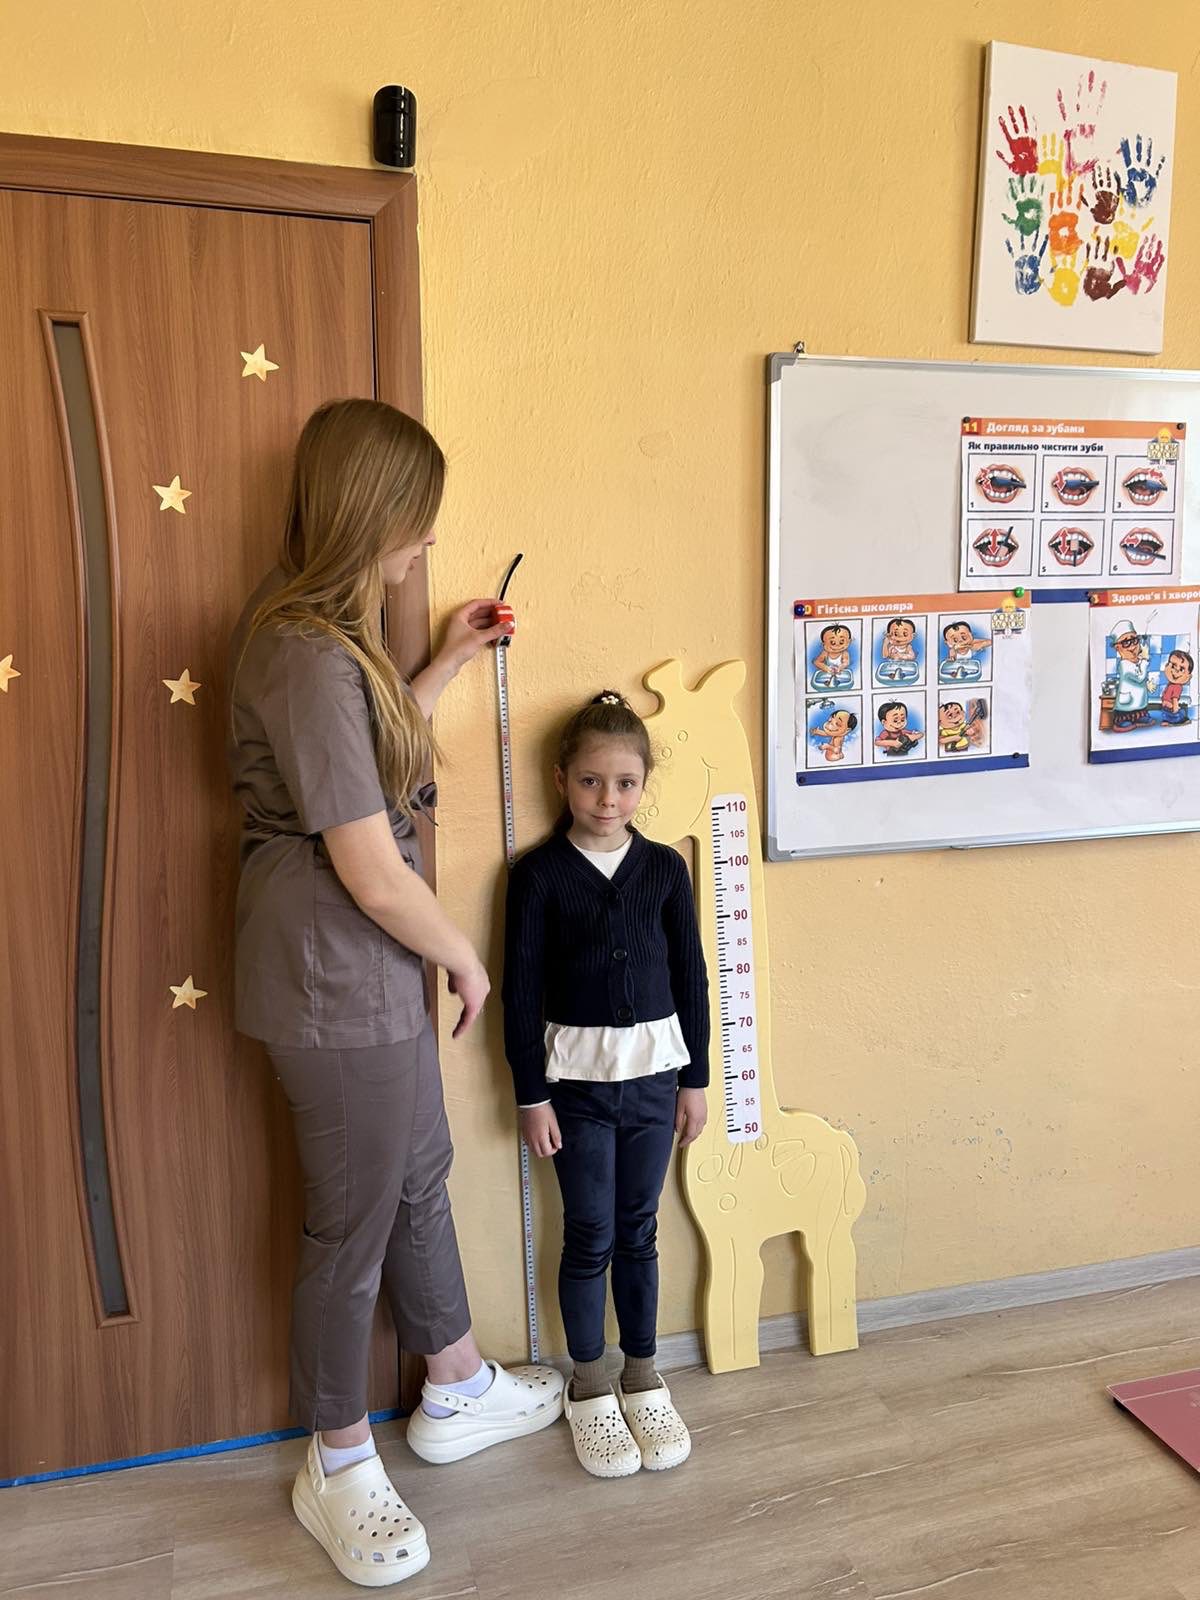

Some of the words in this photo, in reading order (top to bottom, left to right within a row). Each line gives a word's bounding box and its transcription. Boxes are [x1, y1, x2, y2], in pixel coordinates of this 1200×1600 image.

[963, 421, 978, 432] 11
[986, 422, 1029, 434] Догляд
[1032, 423, 1044, 433] за
[1046, 423, 1085, 435] зубами
[968, 441, 981, 450] Як
[984, 442, 1039, 452] правильно
[1041, 443, 1078, 452] чистити
[1080, 443, 1104, 453] зуби
[1111, 591, 1160, 604] Здоров'я
[1163, 591, 1167, 599] і
[861, 602, 914, 613] школяра
[726, 801, 746, 812] 110
[730, 830, 745, 838] 105
[728, 855, 749, 867] 100
[735, 884, 745, 892] 95
[733, 909, 748, 920] 90
[737, 937, 747, 946] 85
[736, 963, 750, 974] 80
[739, 991, 750, 999] 75
[739, 1016, 753, 1027] 70
[742, 1044, 752, 1053] 65
[741, 1069, 755, 1081] 60
[745, 1097, 755, 1106] 55
[744, 1122, 758, 1133] 50
